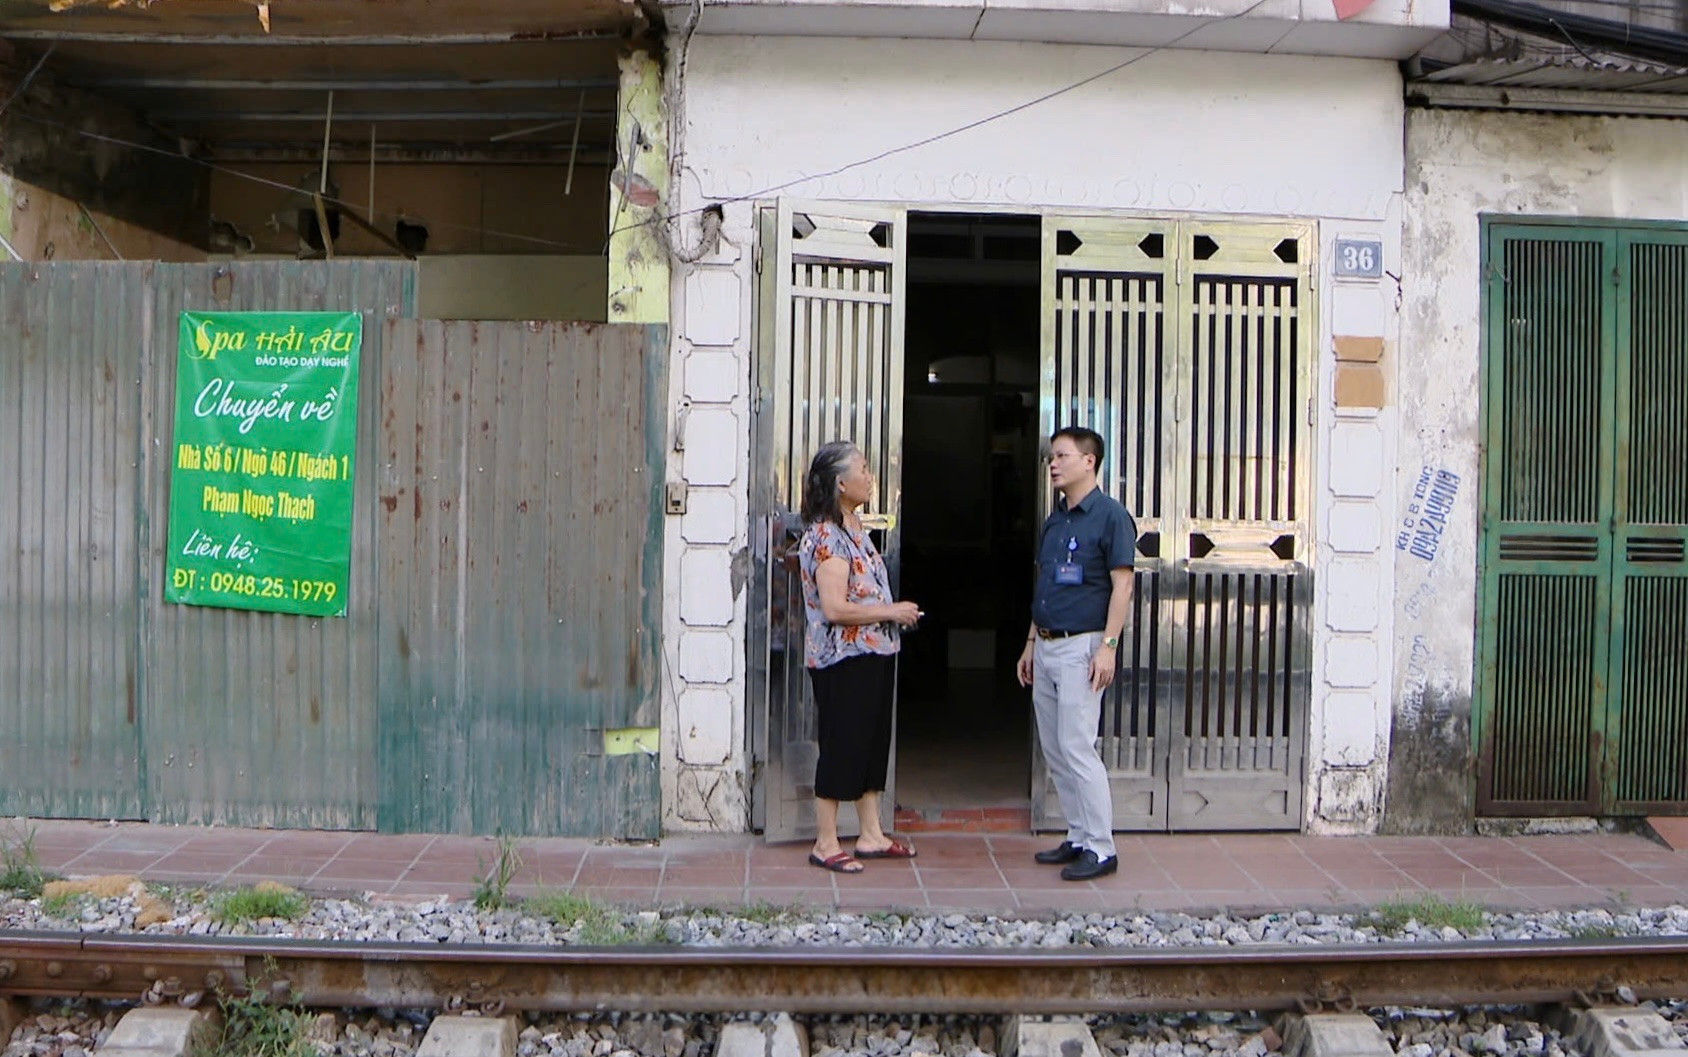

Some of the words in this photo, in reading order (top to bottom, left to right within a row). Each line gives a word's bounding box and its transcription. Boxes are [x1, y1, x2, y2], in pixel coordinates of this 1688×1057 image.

[1344, 246, 1374, 271] 36
[187, 320, 248, 360] Spa
[255, 325, 304, 354] HẢI
[309, 328, 354, 354] ÂU
[255, 354, 277, 366] ĐÀO
[278, 356, 299, 368] TẠO
[300, 356, 321, 369] DẠY
[194, 378, 295, 434] Chuyển
[300, 386, 338, 421] về
[178, 444, 201, 470] Nhà
[203, 442, 224, 472] Số
[223, 446, 232, 473] 6
[233, 447, 241, 473] /
[270, 450, 287, 477] 46
[288, 451, 296, 478] /
[297, 452, 337, 482] Ngách
[341, 455, 348, 481] 1
[203, 485, 240, 519] Phạm
[242, 489, 274, 522] Ngọc
[278, 491, 315, 525] Thạch
[182, 528, 222, 560] Liên
[173, 568, 197, 590] ĐT
[210, 572, 337, 603] 0948.25.1979
